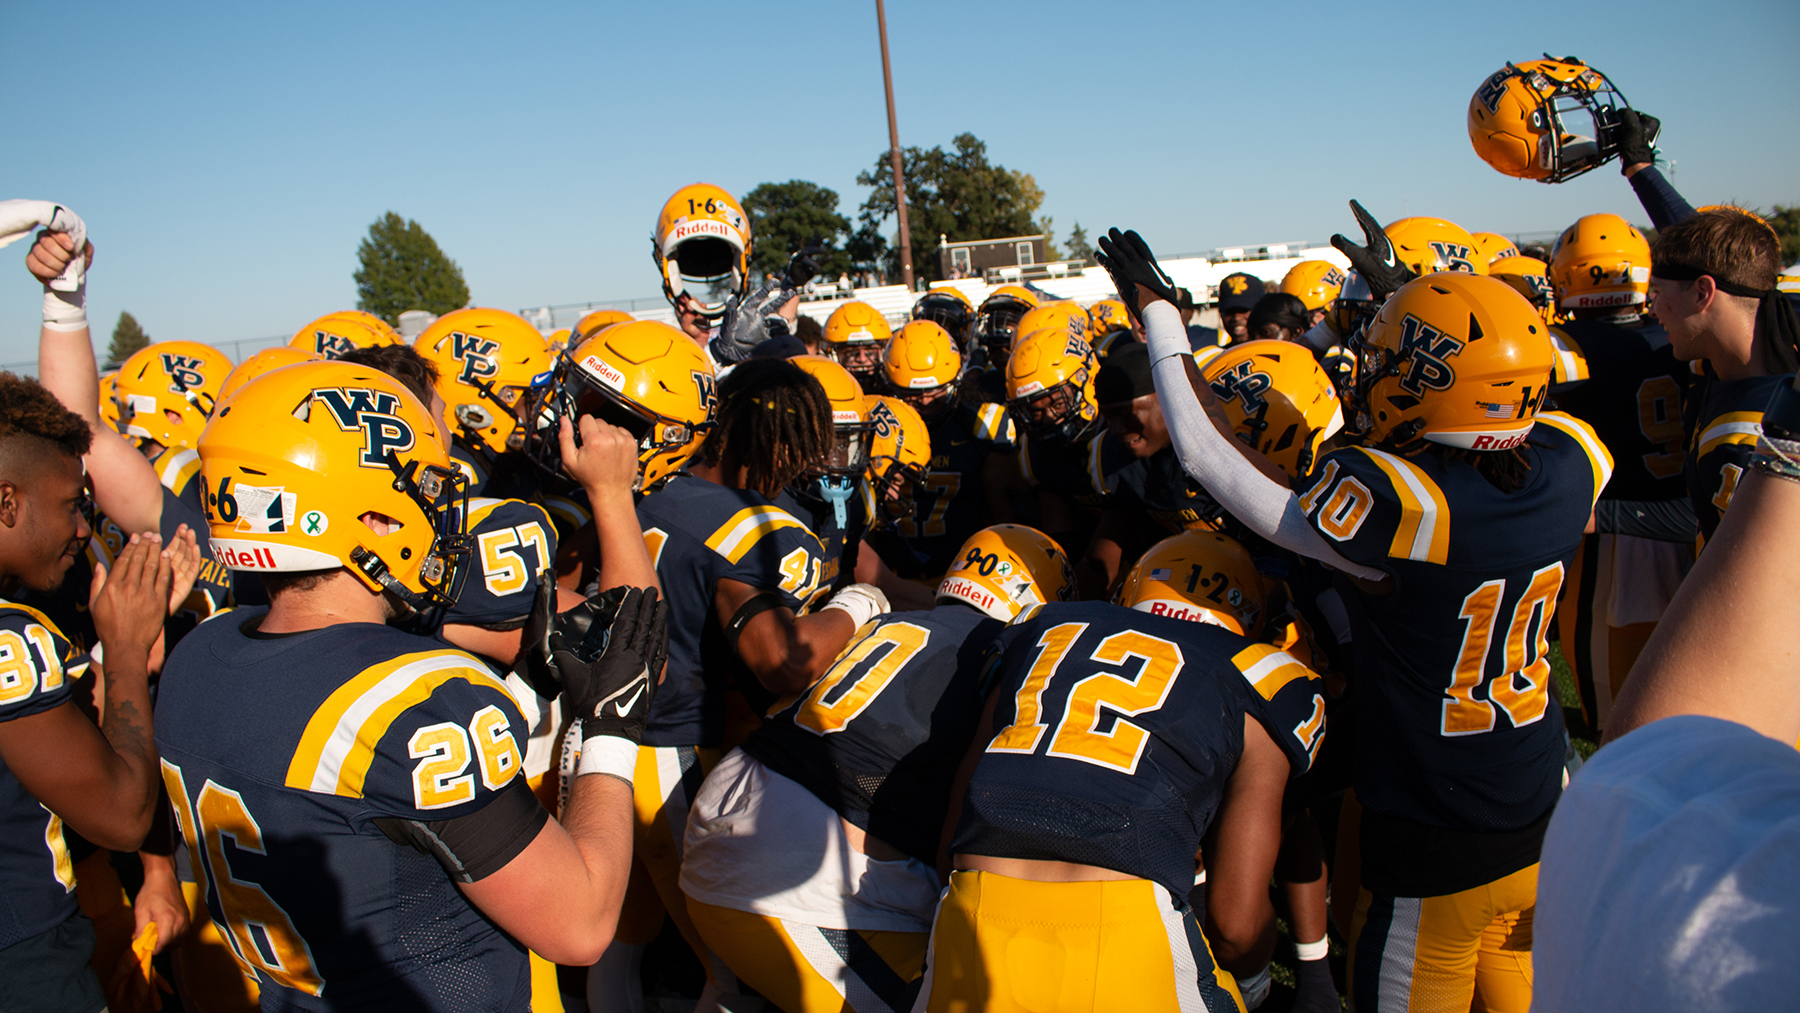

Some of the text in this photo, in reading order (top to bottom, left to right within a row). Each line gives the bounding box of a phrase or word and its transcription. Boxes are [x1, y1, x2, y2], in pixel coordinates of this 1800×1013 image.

[676, 223, 728, 238] Riddell
[1579, 294, 1632, 306] Riddell
[159, 353, 205, 396] WP
[451, 331, 501, 385] WP
[587, 357, 620, 383] Riddell
[1398, 312, 1466, 400] WP
[1209, 358, 1273, 416] WP
[311, 387, 416, 470] WP
[1299, 459, 1374, 542] 10
[477, 521, 551, 597] 57
[777, 546, 821, 601] 41
[942, 580, 995, 610] Riddell
[1150, 602, 1221, 626] Ridd
[0, 624, 63, 706] 81
[1441, 561, 1565, 737] 10
[985, 622, 1185, 775] 12
[408, 704, 523, 811] 26
